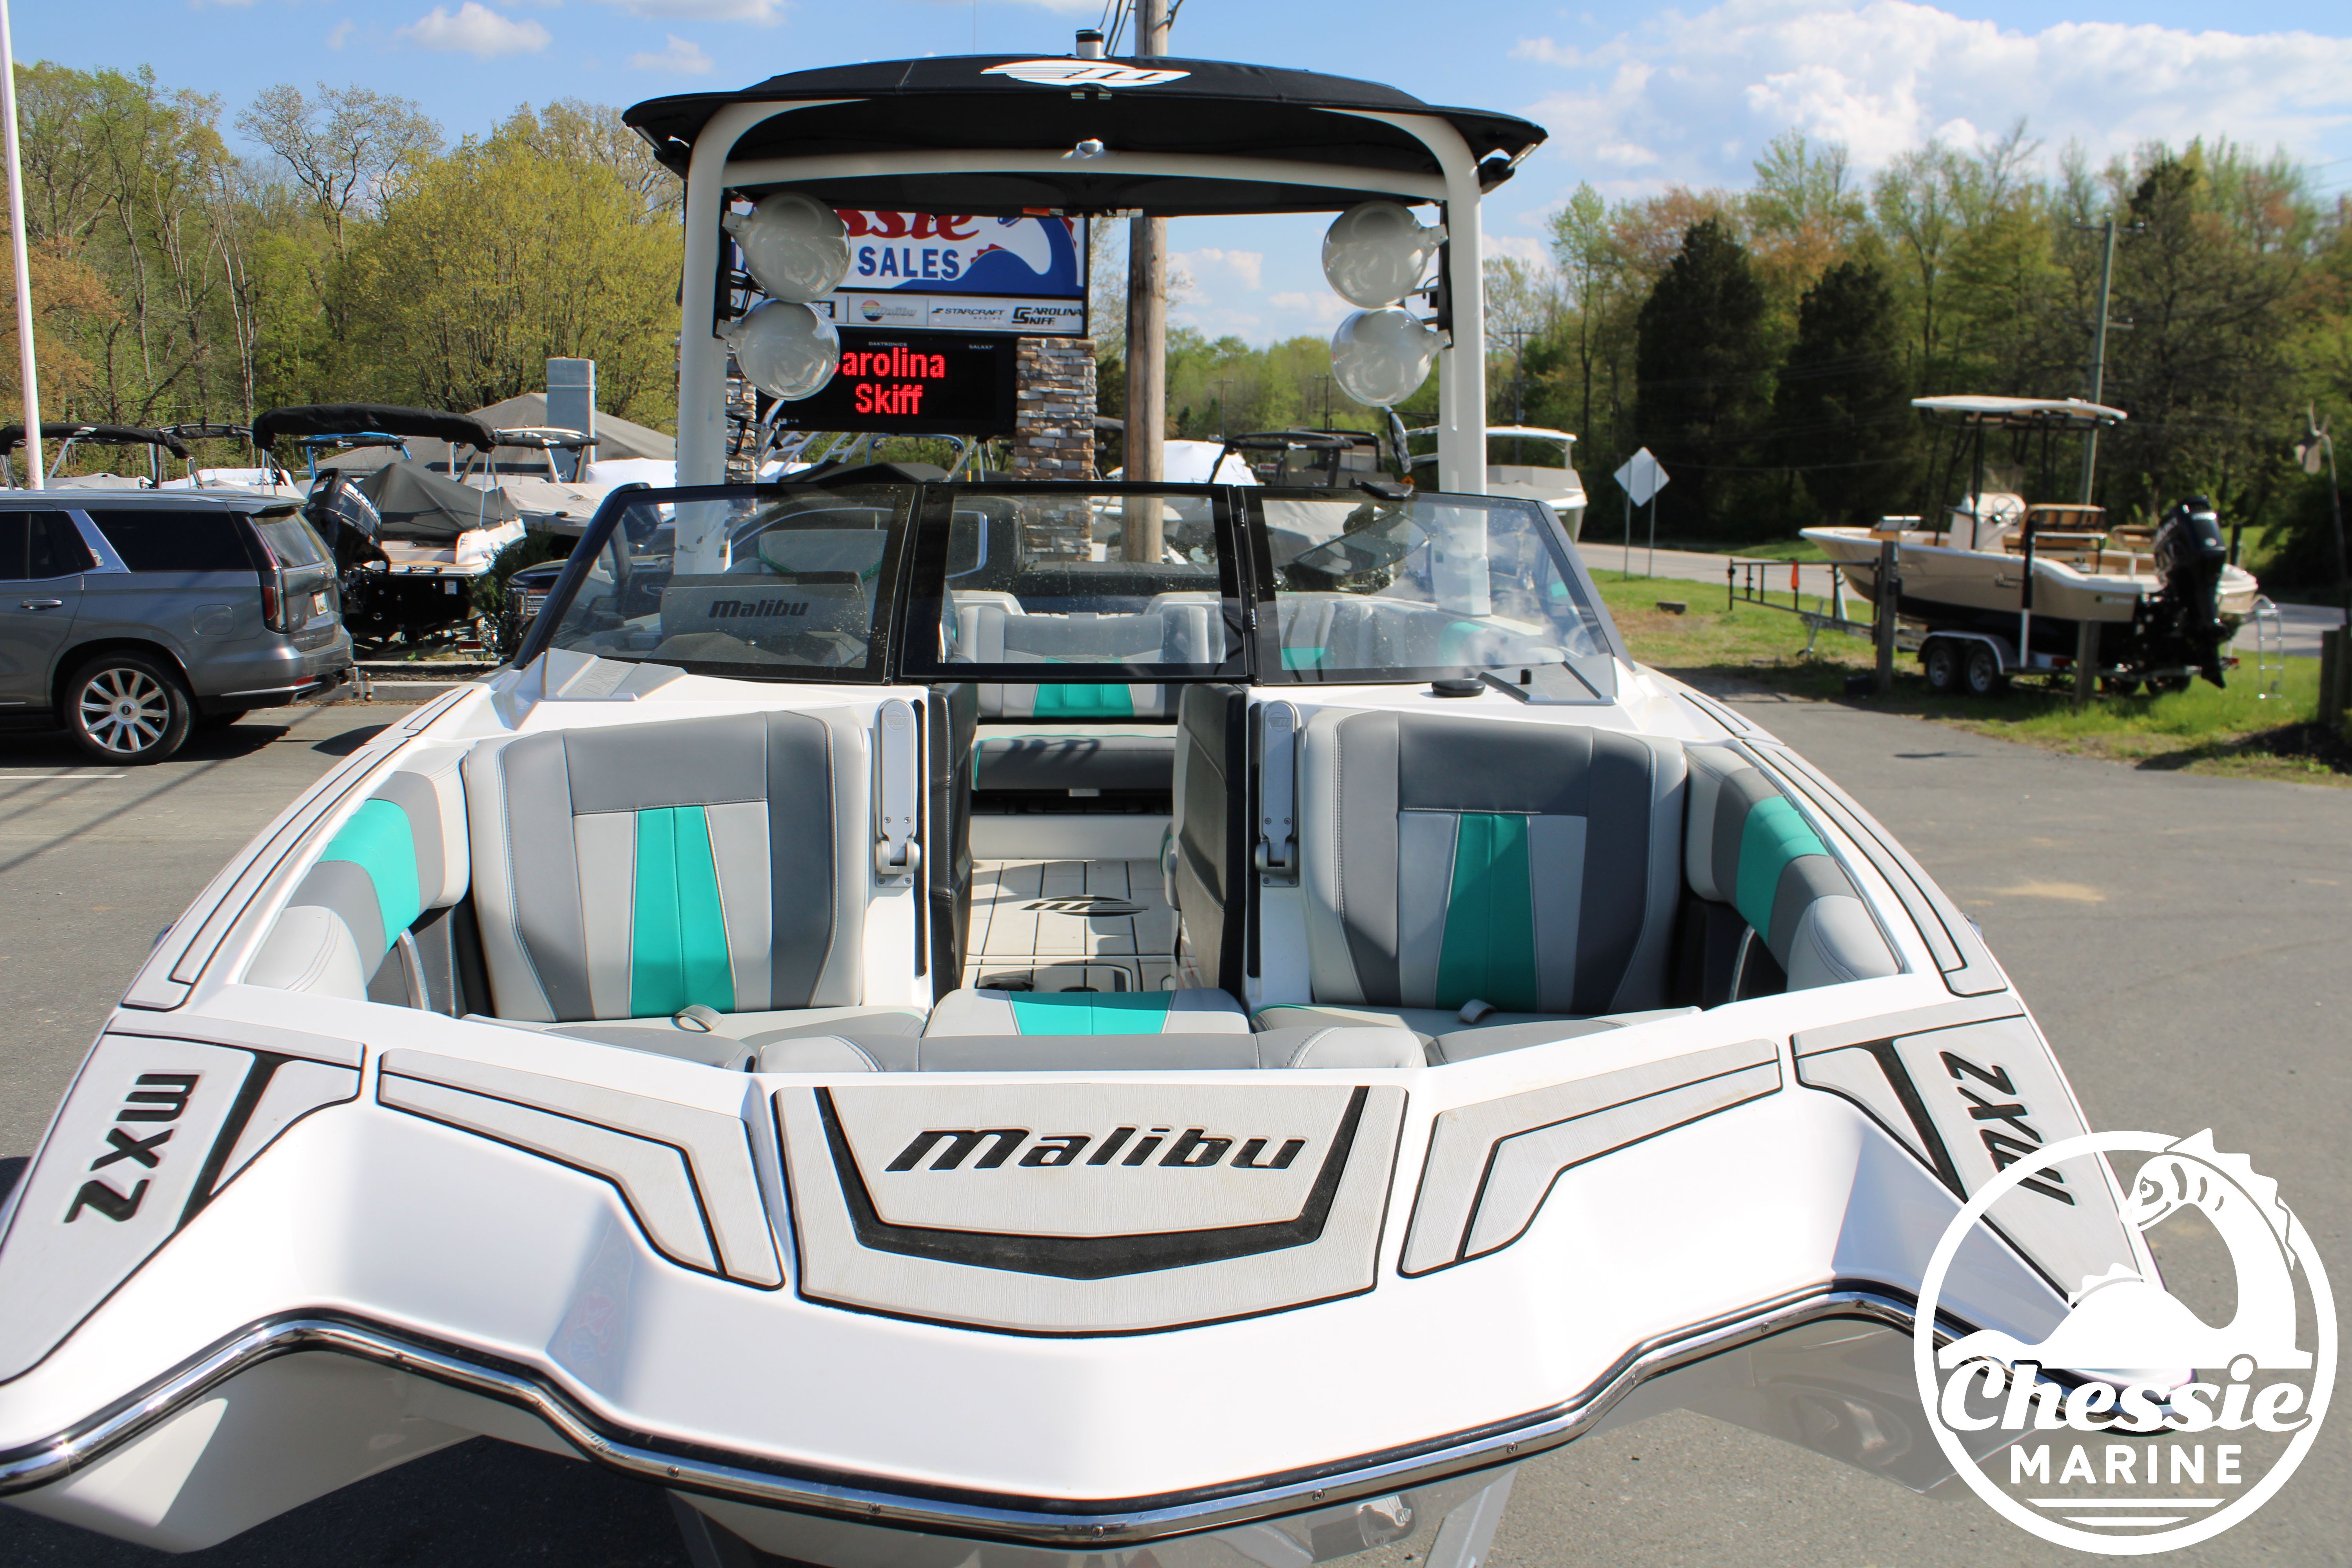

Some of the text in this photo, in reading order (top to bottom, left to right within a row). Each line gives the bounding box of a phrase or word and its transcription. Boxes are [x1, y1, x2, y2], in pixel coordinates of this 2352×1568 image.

[858, 246, 960, 279] SALES
[834, 347, 946, 378] arolina
[855, 383, 923, 414] Skiff
[708, 599, 809, 618] Malibu
[884, 1126, 1305, 1171] Malibu
